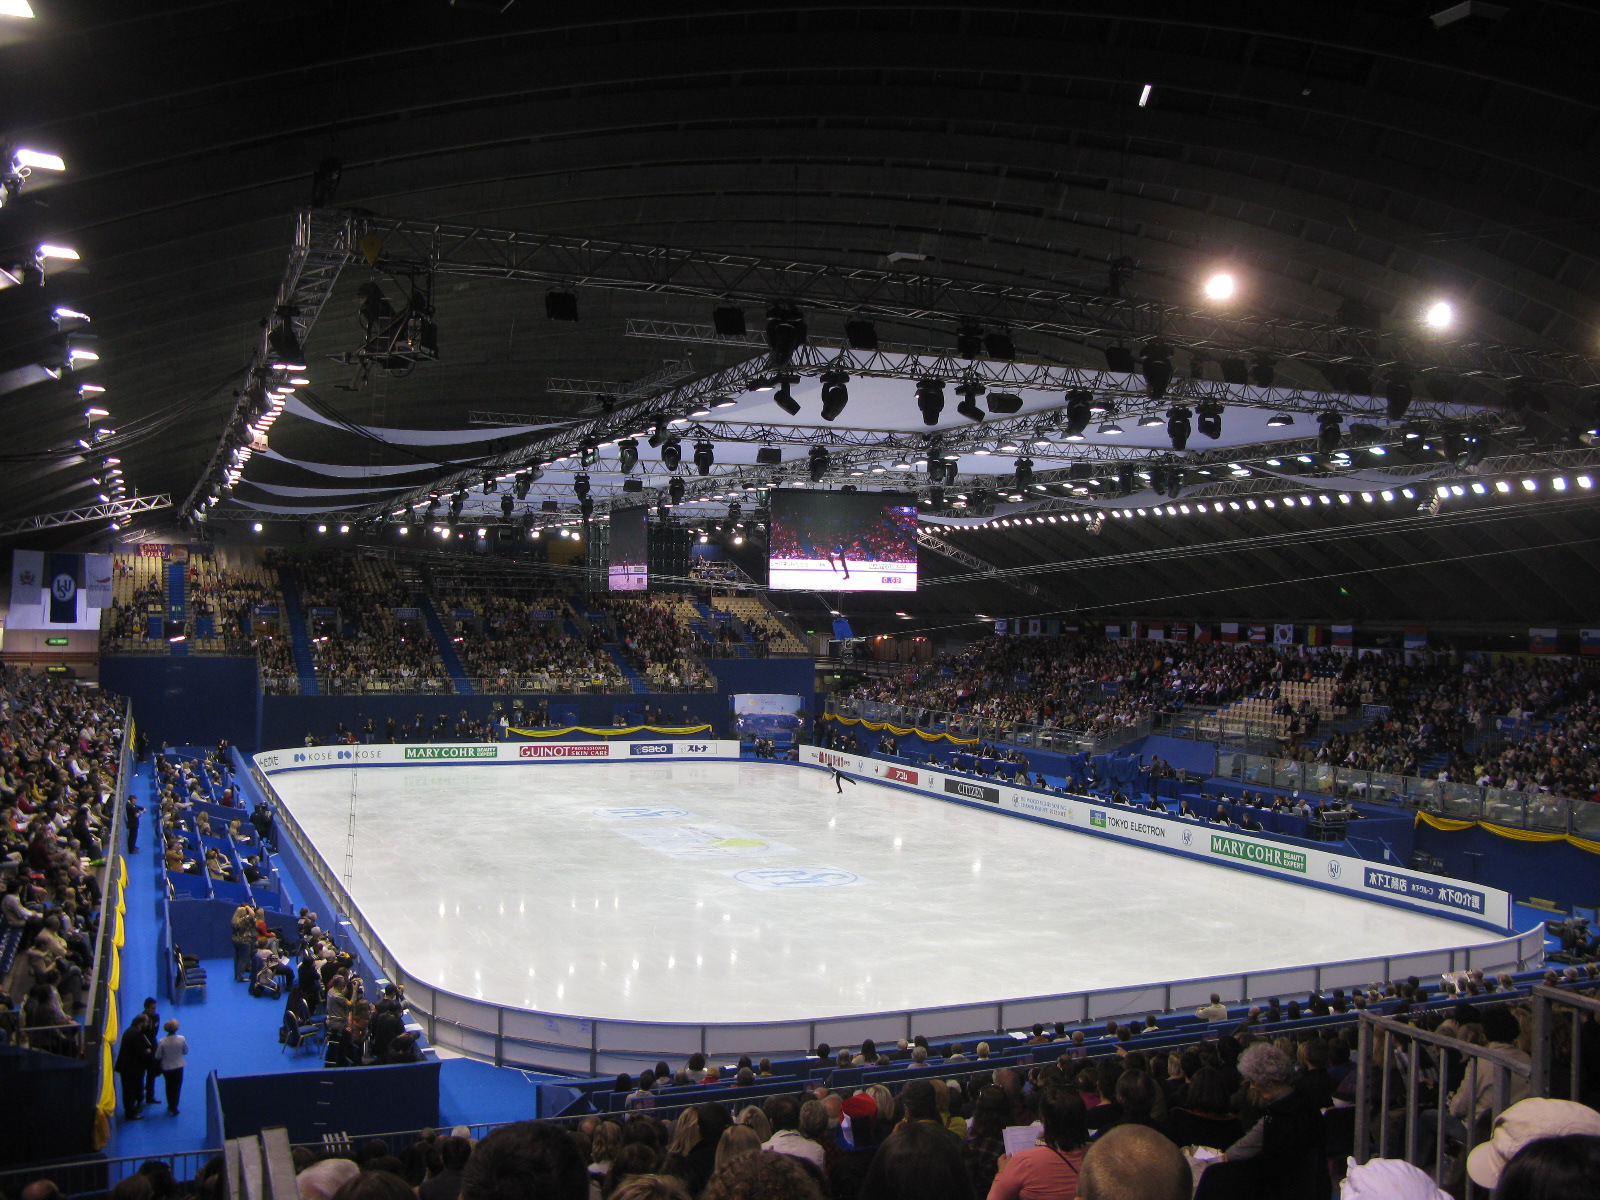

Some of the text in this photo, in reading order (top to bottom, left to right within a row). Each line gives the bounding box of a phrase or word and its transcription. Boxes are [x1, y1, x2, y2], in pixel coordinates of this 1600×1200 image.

[406, 748, 476, 758] MARY COHR
[521, 746, 570, 757] GUINOT
[641, 745, 667, 753] sato
[687, 744, 709, 753] ストナ
[308, 751, 332, 761] KOSÉ
[355, 750, 382, 759] KOSÉ
[957, 783, 985, 799] CITIZEN
[1107, 816, 1166, 838] TOKYO ELECTRON
[1212, 837, 1282, 865] MARY COHR
[1283, 851, 1305, 862] BEAUTY
[1283, 859, 1305, 870] EXPERT
[1369, 871, 1407, 892] 木下工務店
[1437, 887, 1480, 910] 木下の介護
